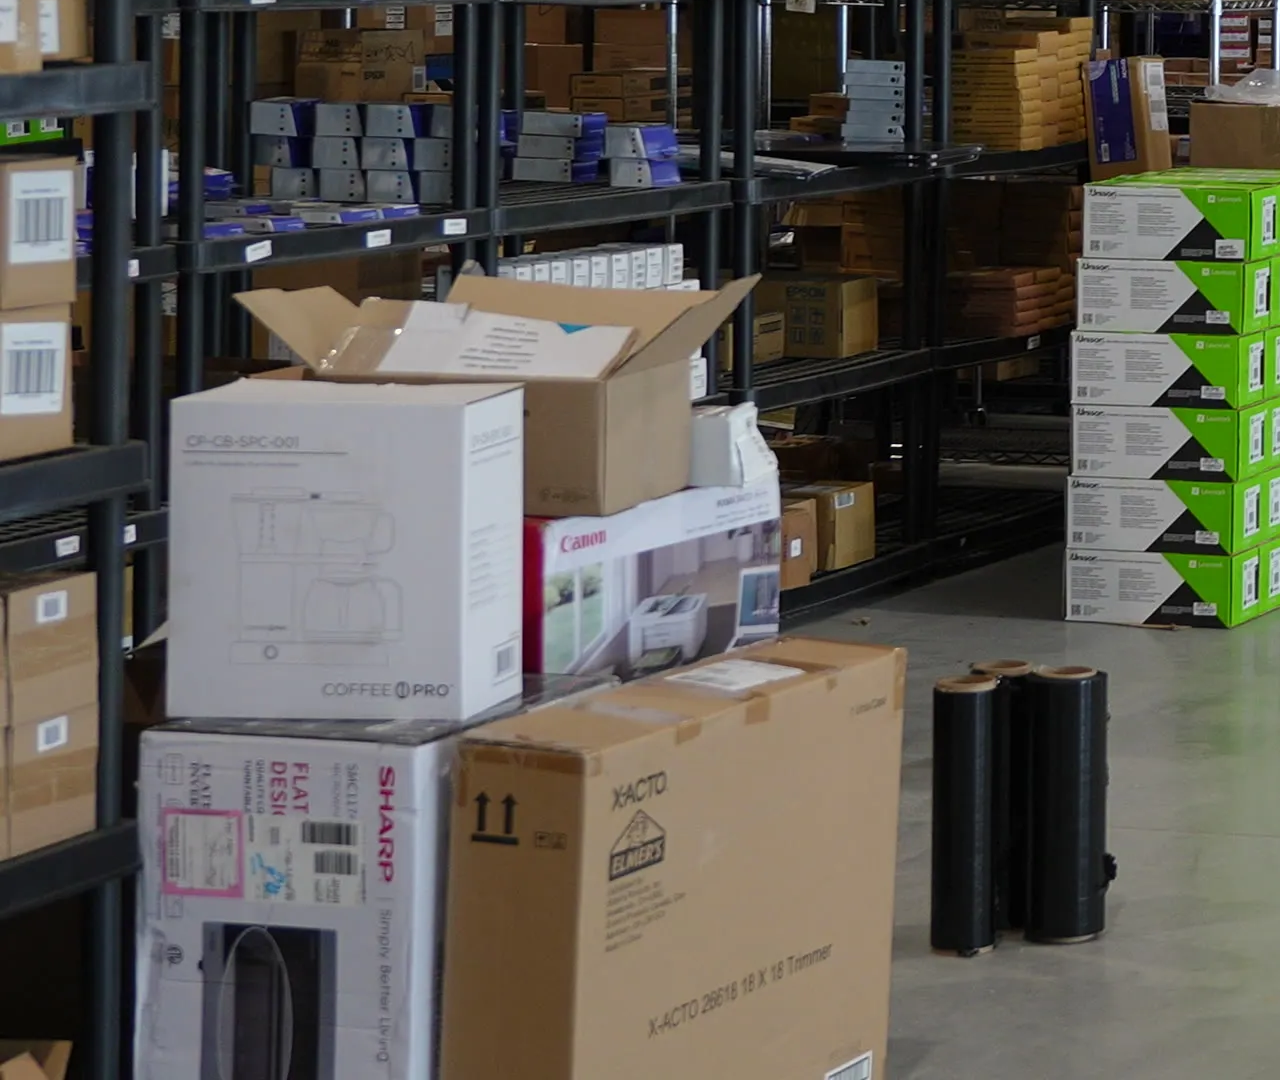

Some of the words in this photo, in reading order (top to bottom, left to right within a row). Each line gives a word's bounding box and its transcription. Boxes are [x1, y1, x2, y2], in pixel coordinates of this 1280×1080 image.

[786, 285, 826, 298] EPSON
[560, 529, 607, 554] Canon
[321, 682, 393, 698] COFFEE
[413, 683, 450, 698] PRO
[292, 761, 309, 814] FLAT
[612, 770, 668, 811] X-ACTO
[378, 765, 396, 883] SHARP
[376, 909, 392, 959] Simply
[379, 965, 392, 1013] Better
[648, 999, 699, 1039] X-ACTO
[756, 967, 768, 989] X
[786, 943, 833, 976] Trimmer
[375, 1017, 392, 1062] Living
